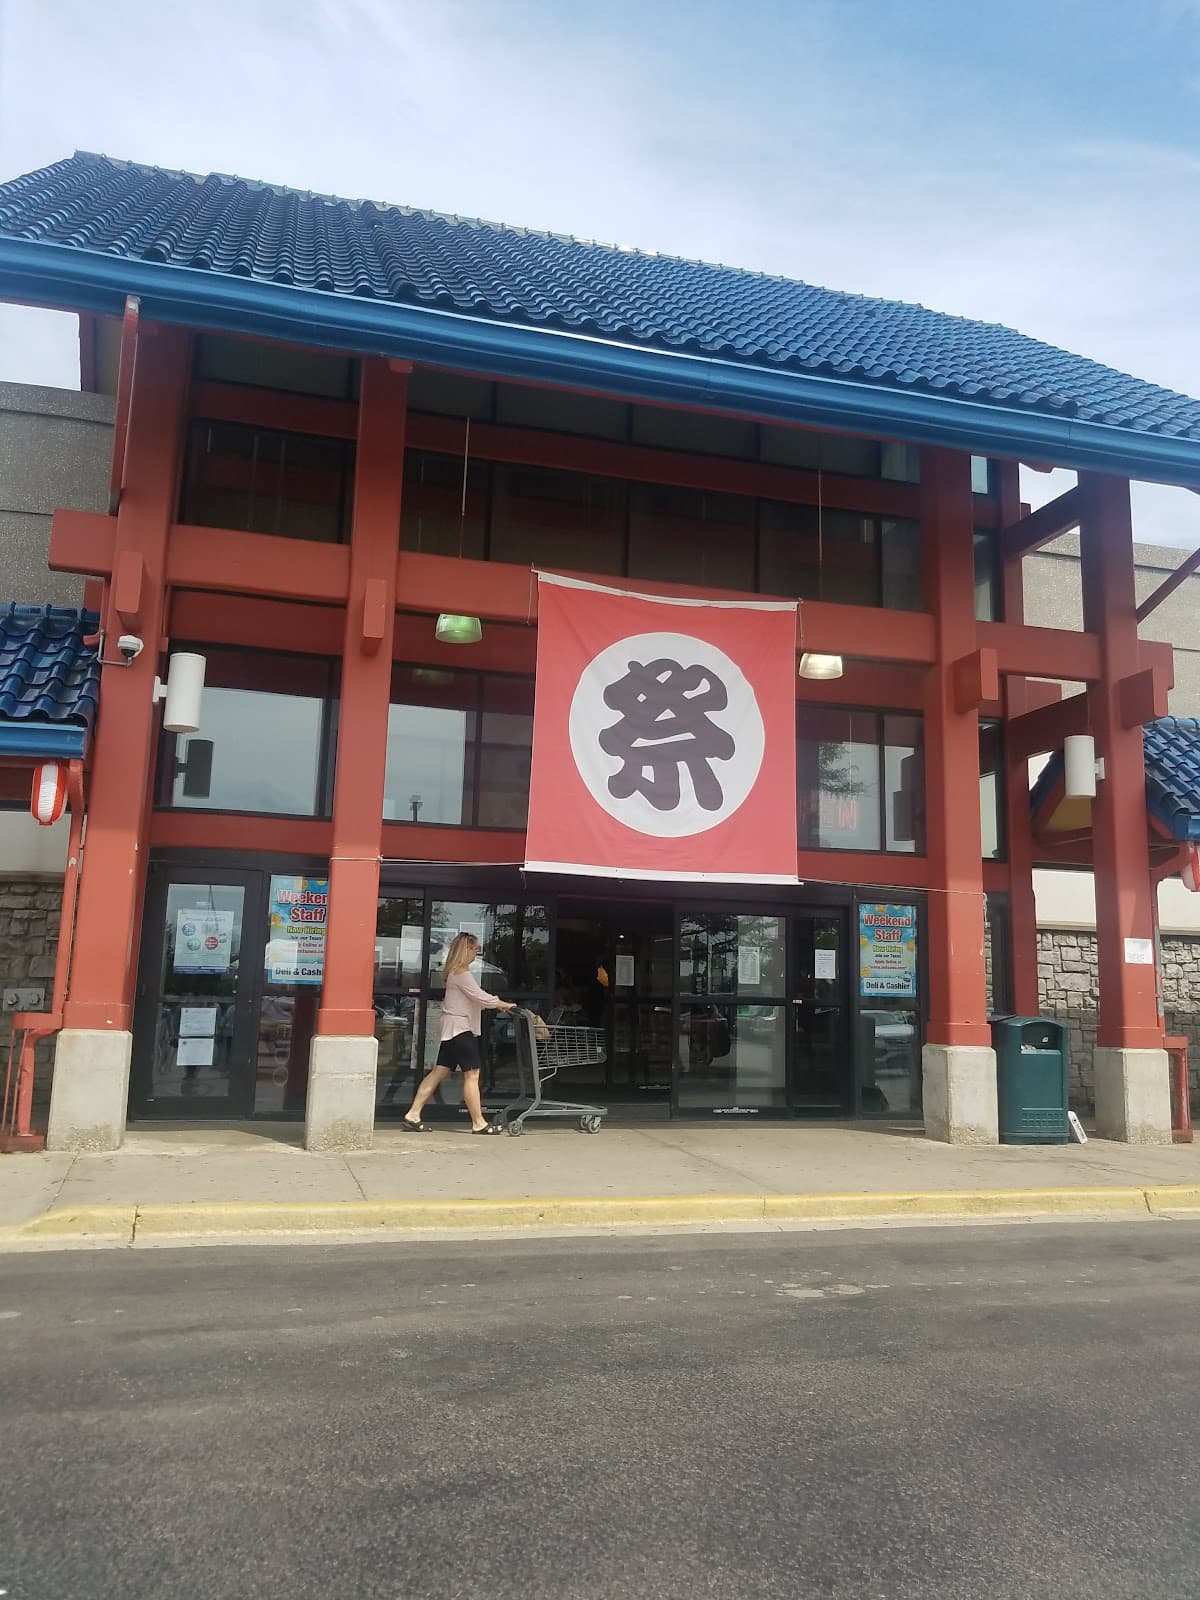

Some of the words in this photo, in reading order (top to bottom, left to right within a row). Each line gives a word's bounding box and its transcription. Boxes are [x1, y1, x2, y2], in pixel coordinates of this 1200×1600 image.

[598, 658, 735, 811] 祭
[291, 907, 325, 921] Staff
[864, 914, 911, 927] Weekend
[287, 925, 303, 934] Now
[304, 926, 326, 936] Hiring
[875, 930, 901, 941] Staff
[275, 967, 292, 976] Deli
[292, 968, 300, 976] &
[865, 981, 879, 989] Deli
[879, 981, 885, 989] &
[885, 982, 911, 990] Cashier
